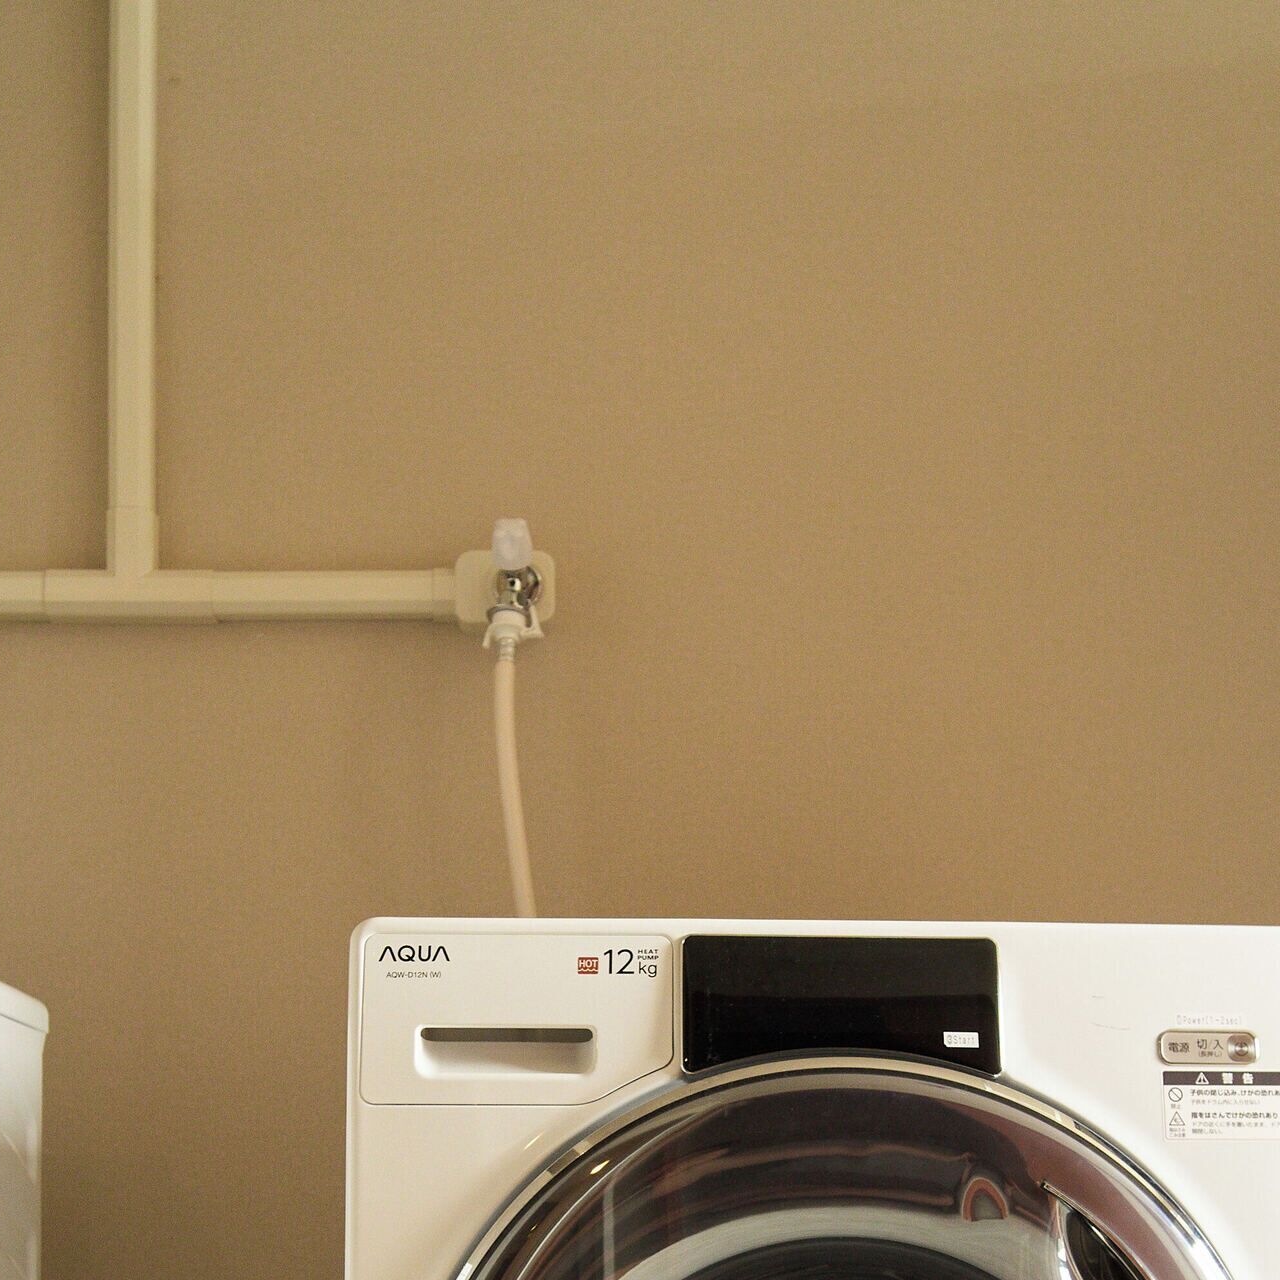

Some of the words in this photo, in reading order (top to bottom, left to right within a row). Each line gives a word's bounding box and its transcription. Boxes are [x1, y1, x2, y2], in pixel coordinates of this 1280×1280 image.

[379, 945, 450, 962] AQUA
[579, 959, 598, 968] HOT
[604, 949, 634, 974] 12
[639, 961, 657, 978] kg
[386, 971, 428, 979] AQW-D12N
[430, 971, 441, 979] (W)
[1168, 1042, 1190, 1053] 電源
